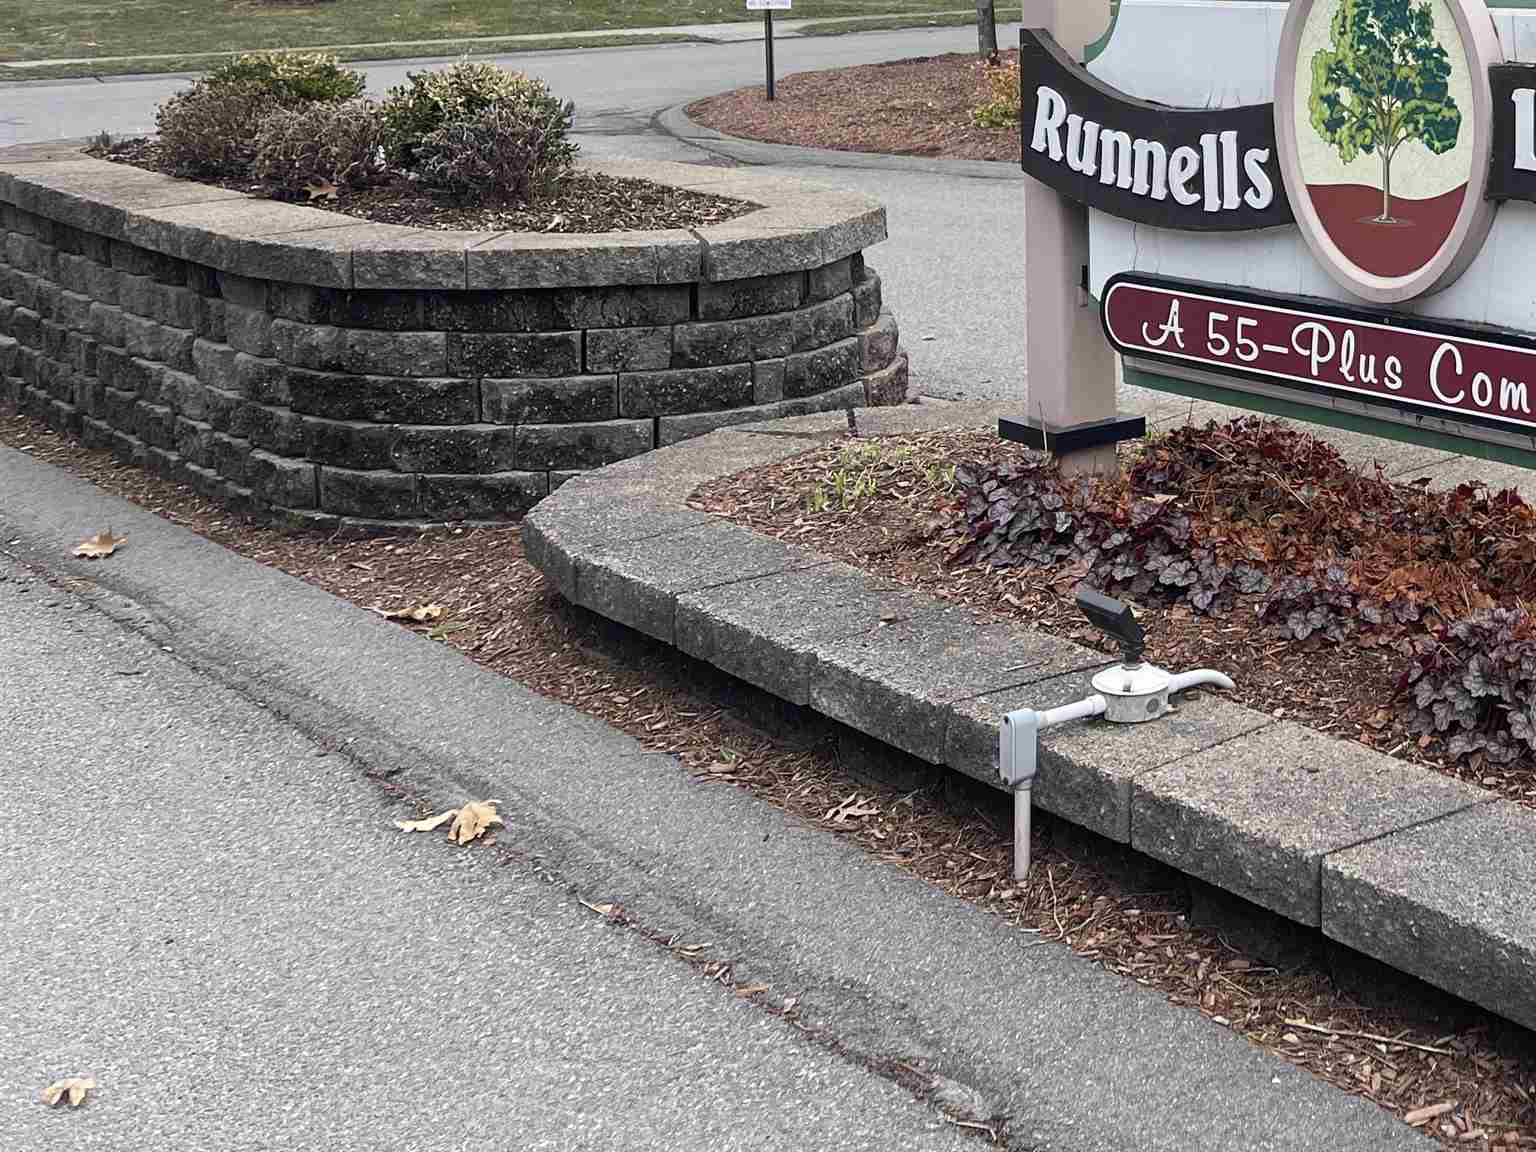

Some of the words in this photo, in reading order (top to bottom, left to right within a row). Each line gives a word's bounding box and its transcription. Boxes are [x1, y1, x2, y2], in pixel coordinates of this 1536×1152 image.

[1031, 85, 1274, 212] Runnells
[1142, 299, 1184, 348] A
[1206, 311, 1403, 390] 55-Plus
